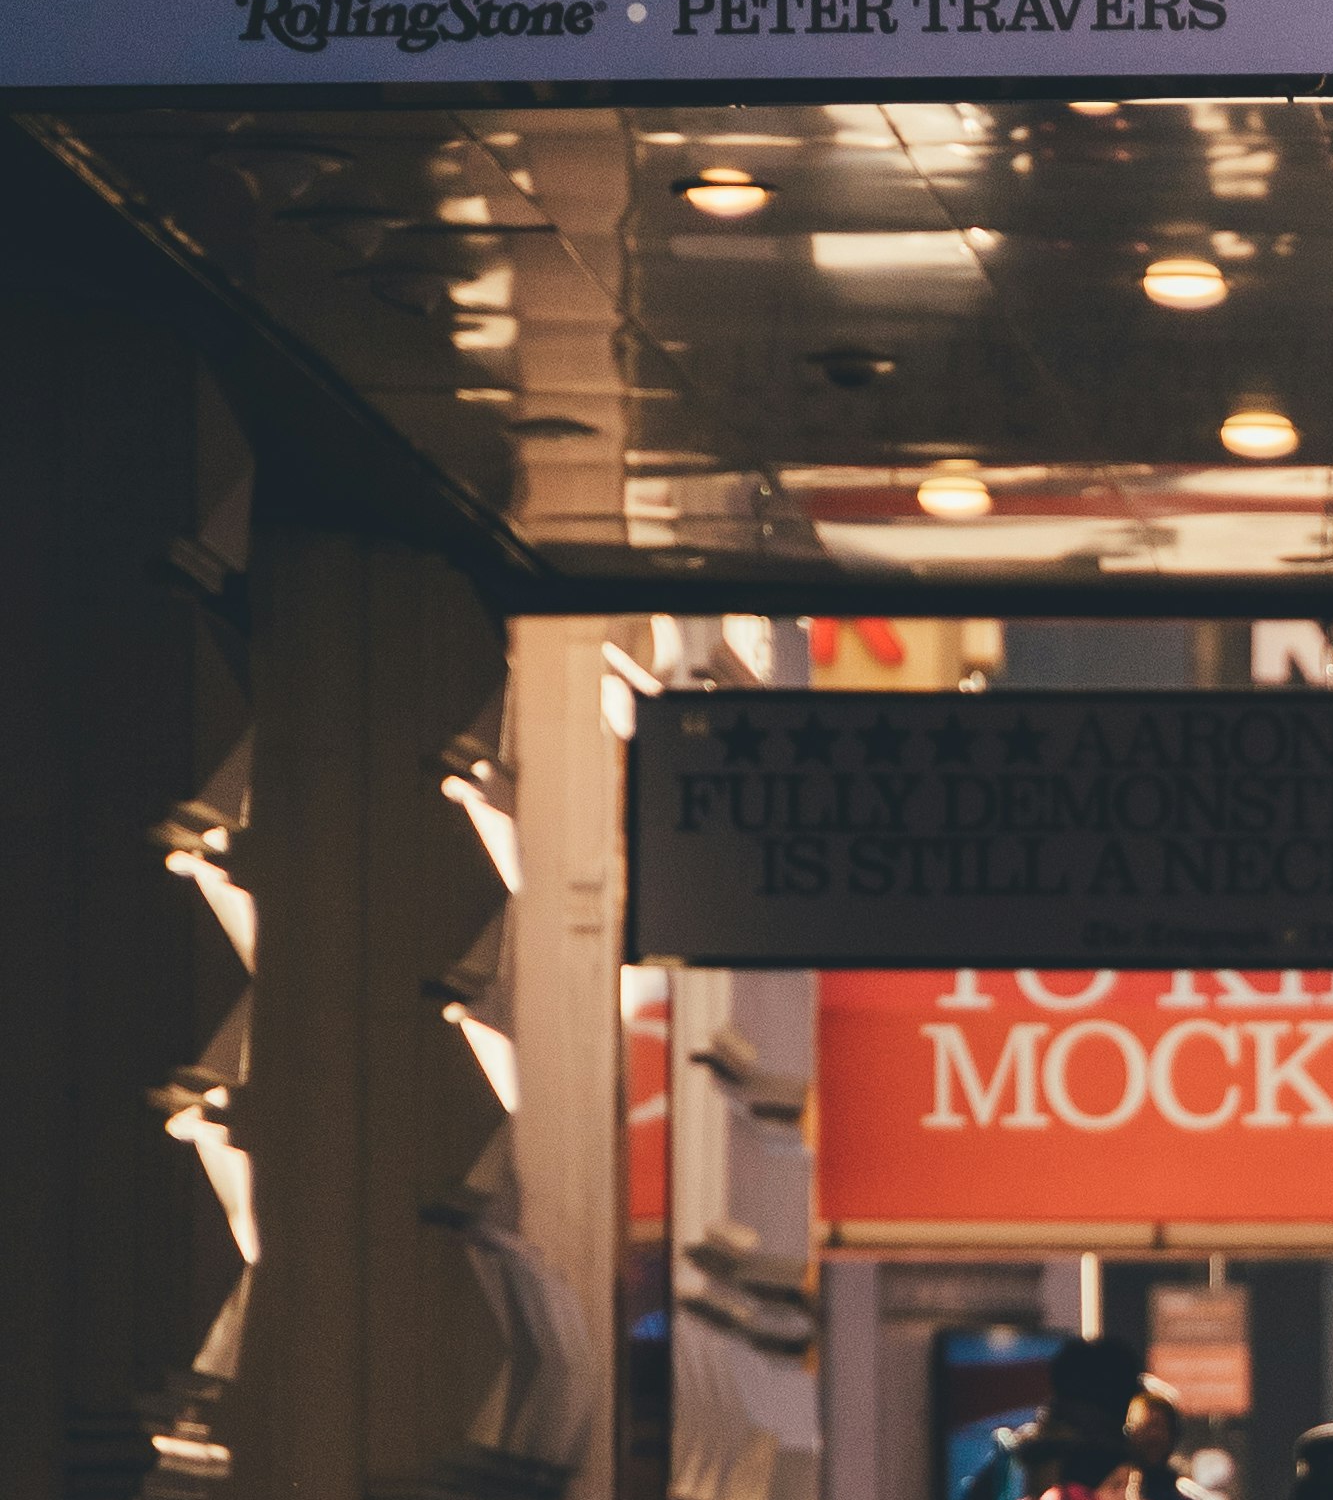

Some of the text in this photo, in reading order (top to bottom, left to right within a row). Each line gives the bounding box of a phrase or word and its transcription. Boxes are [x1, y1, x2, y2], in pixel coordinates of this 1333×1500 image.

[674, 771, 923, 835] FULLY
[756, 835, 831, 898] IS
[847, 835, 1071, 898] STILL
[1085, 836, 1139, 898] A
